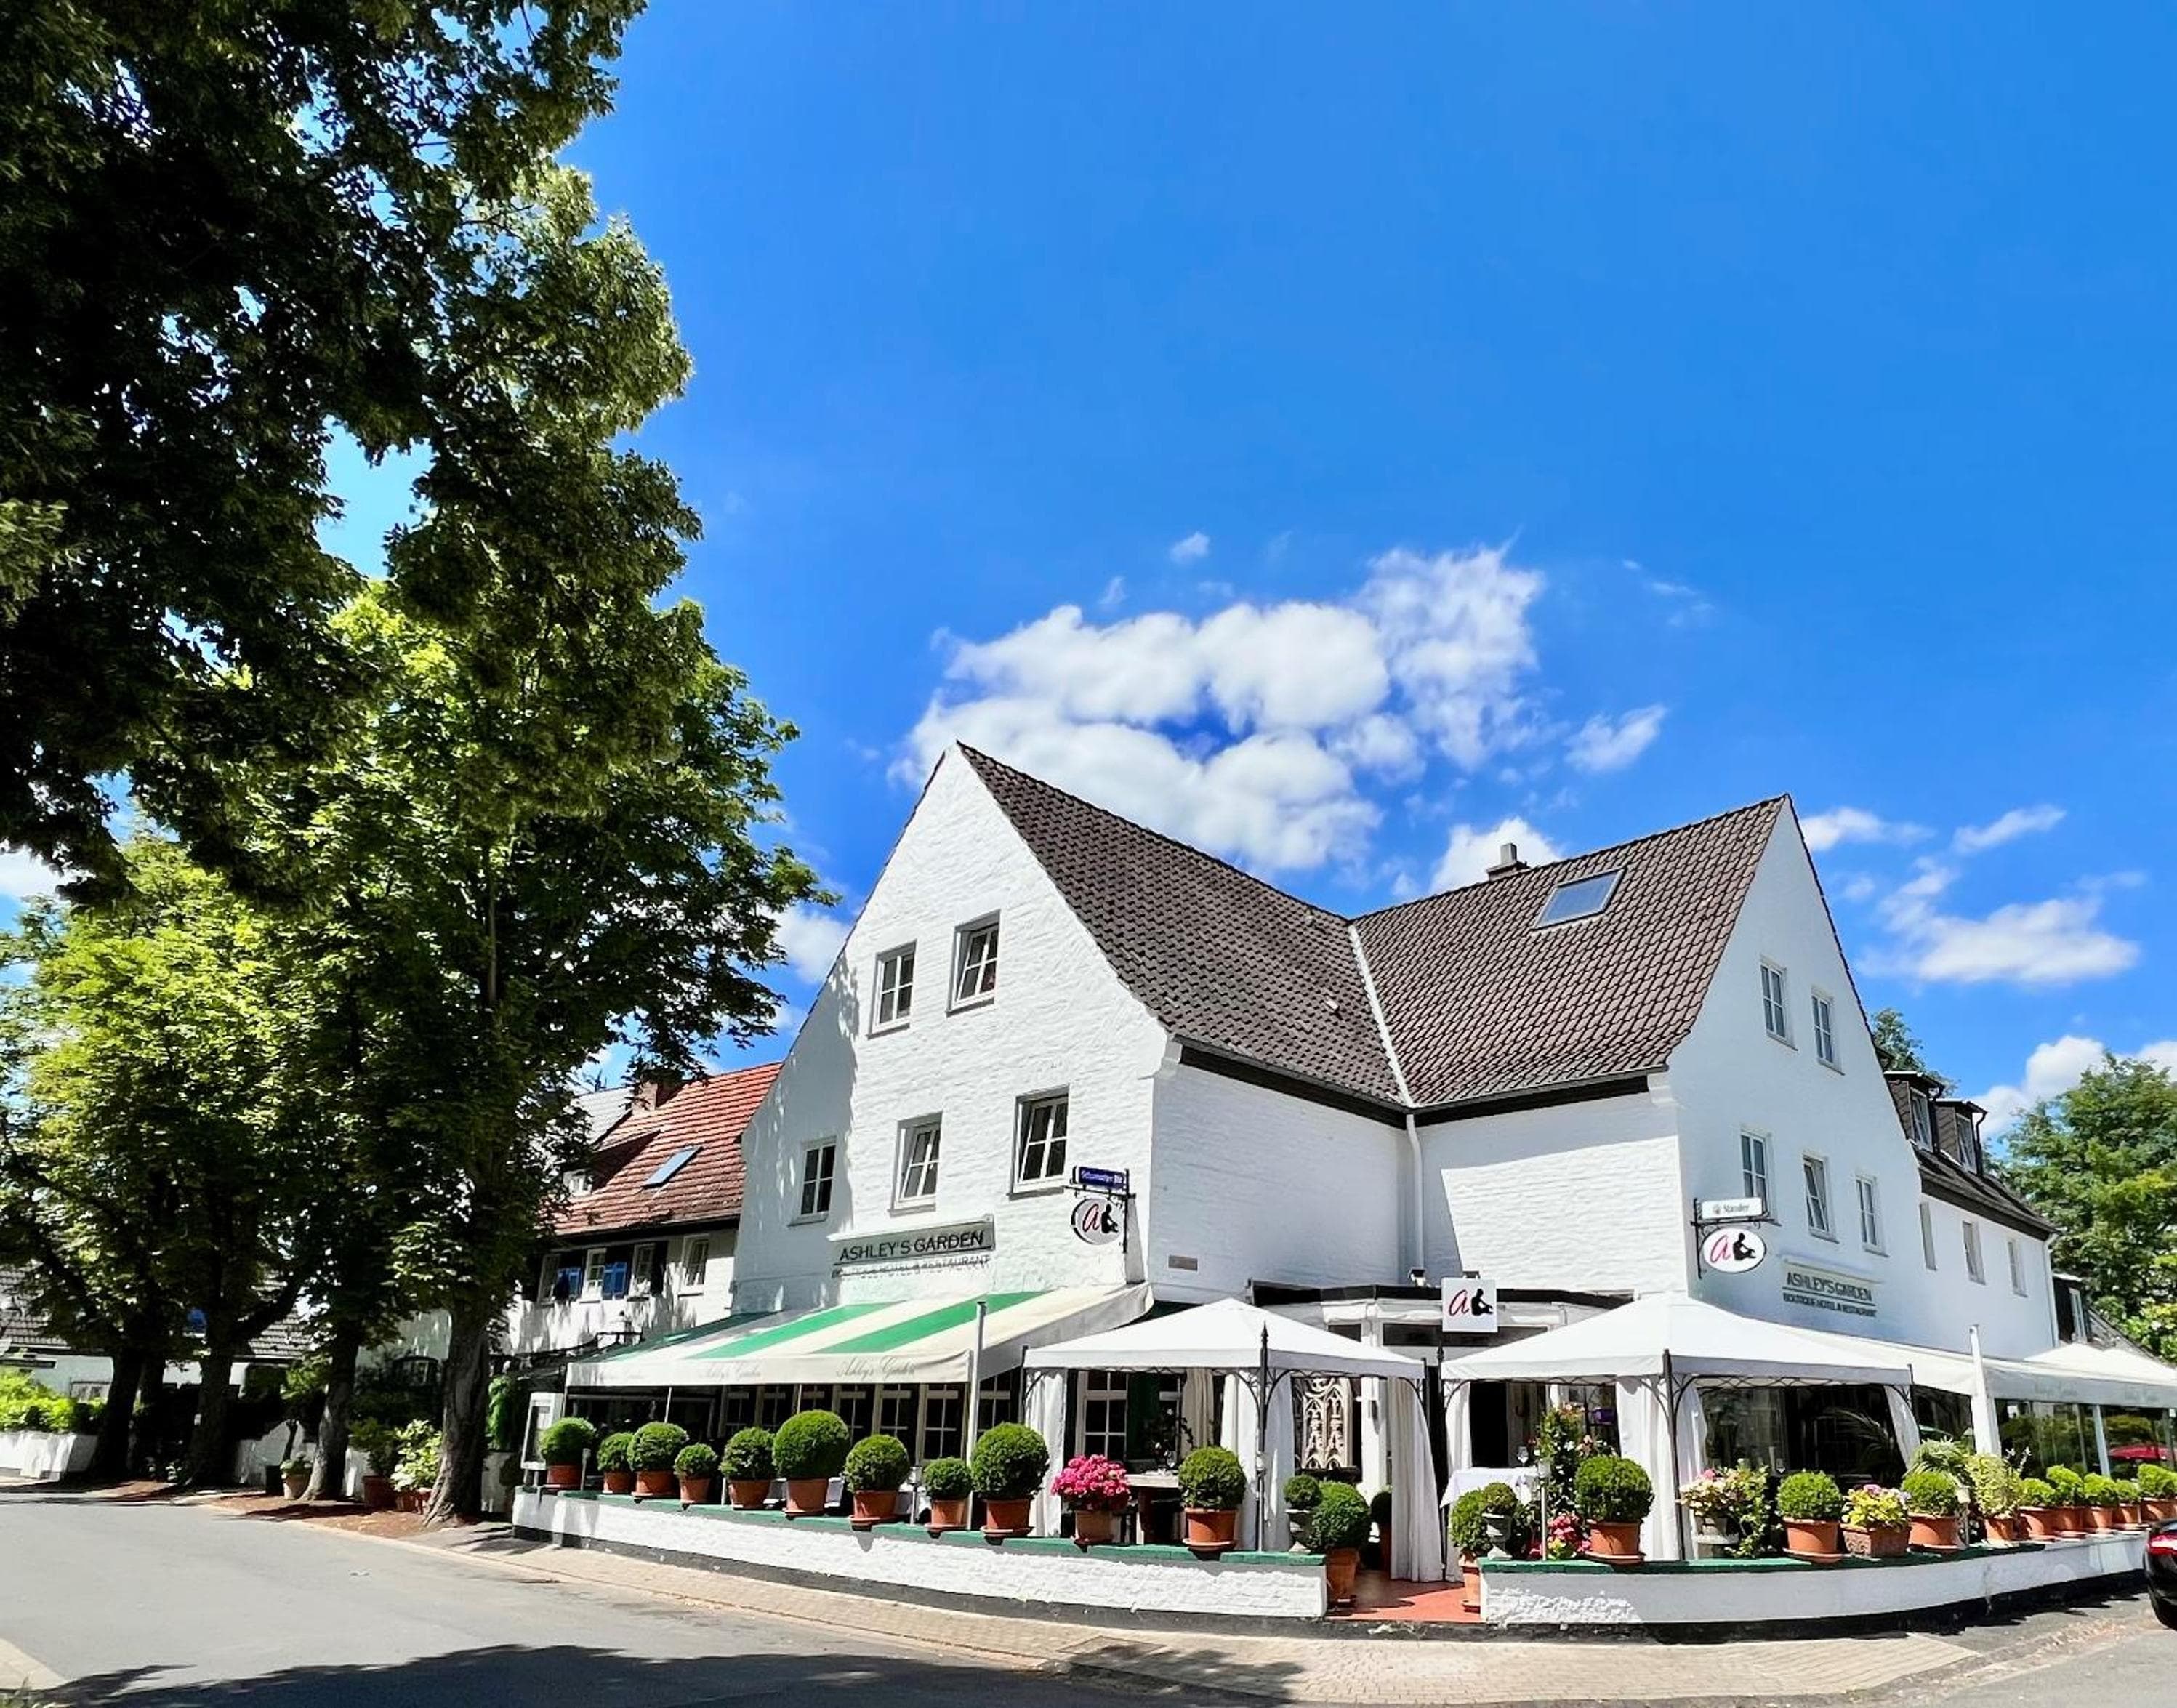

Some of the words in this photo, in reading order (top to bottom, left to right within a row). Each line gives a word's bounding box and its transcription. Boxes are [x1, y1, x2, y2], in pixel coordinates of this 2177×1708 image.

[839, 1240, 910, 1261] ASHLEY'S
[914, 1230, 984, 1252] GARDEN
[1787, 1272, 1835, 1294] ASHLEY'S
[1835, 1283, 1872, 1301] GARDEN
